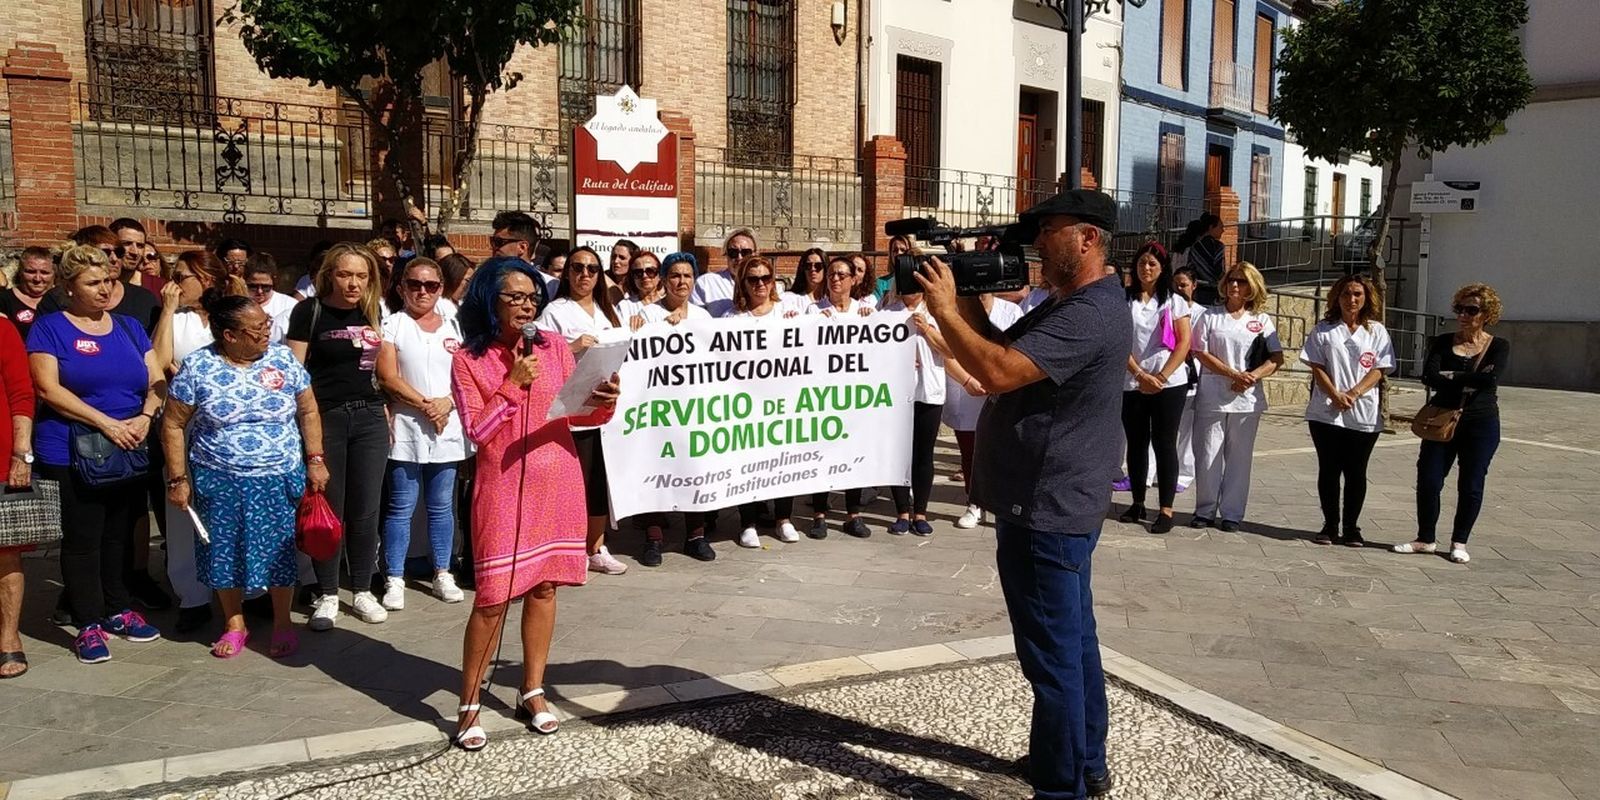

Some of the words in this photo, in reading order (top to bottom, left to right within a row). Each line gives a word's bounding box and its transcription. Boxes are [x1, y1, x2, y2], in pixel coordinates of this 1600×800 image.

[590, 122, 599, 130] El
[601, 122, 627, 133] legado
[582, 178, 610, 189] Ruta
[612, 178, 629, 190] del
[631, 179, 674, 193] Califato
[585, 240, 613, 252] Pino
[641, 245, 667, 253] ente
[623, 332, 695, 363] NIDOS
[709, 329, 767, 352] ANTE
[783, 327, 804, 348] EL
[817, 323, 910, 346] IMPAGO
[647, 356, 813, 389] INSTITUCIONAL
[828, 353, 869, 374] DEL
[623, 392, 753, 435] SERVICIO
[763, 398, 786, 416] DE
[795, 383, 893, 413] AYUDA
[660, 441, 676, 458] A
[689, 415, 850, 458] DOMICILIO.
[740, 449, 825, 475] cumplimos,
[692, 489, 717, 505] las
[725, 466, 818, 498] instituciones
